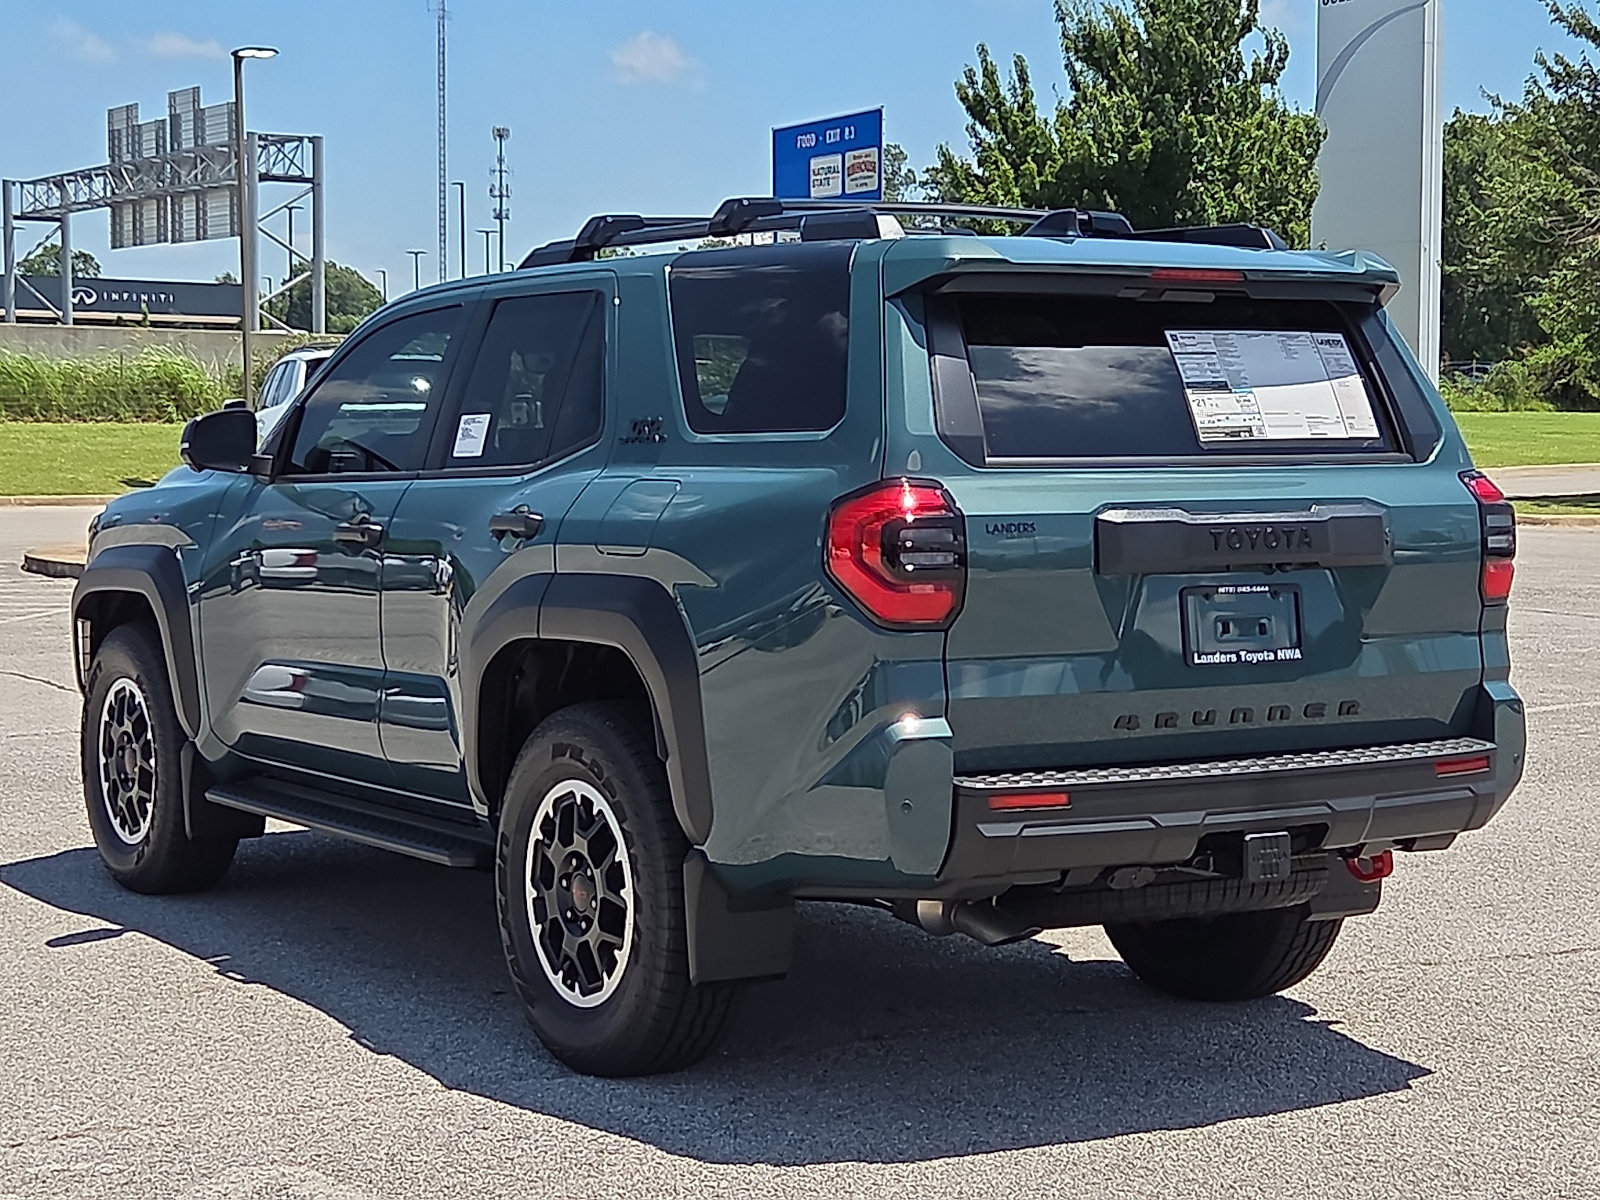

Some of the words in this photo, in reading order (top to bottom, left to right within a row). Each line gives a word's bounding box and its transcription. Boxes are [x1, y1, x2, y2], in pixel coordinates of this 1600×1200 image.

[812, 164, 840, 176] NATURAL
[812, 177, 831, 188] STATE
[102, 291, 175, 303] INFINITI
[985, 522, 1037, 535] LANDERS
[1209, 527, 1313, 551] TOYOTA
[1193, 651, 1238, 665] Landers
[1239, 650, 1275, 664] Toyota
[1277, 648, 1303, 662] NWA
[1113, 699, 1362, 731] 4RUNNER
